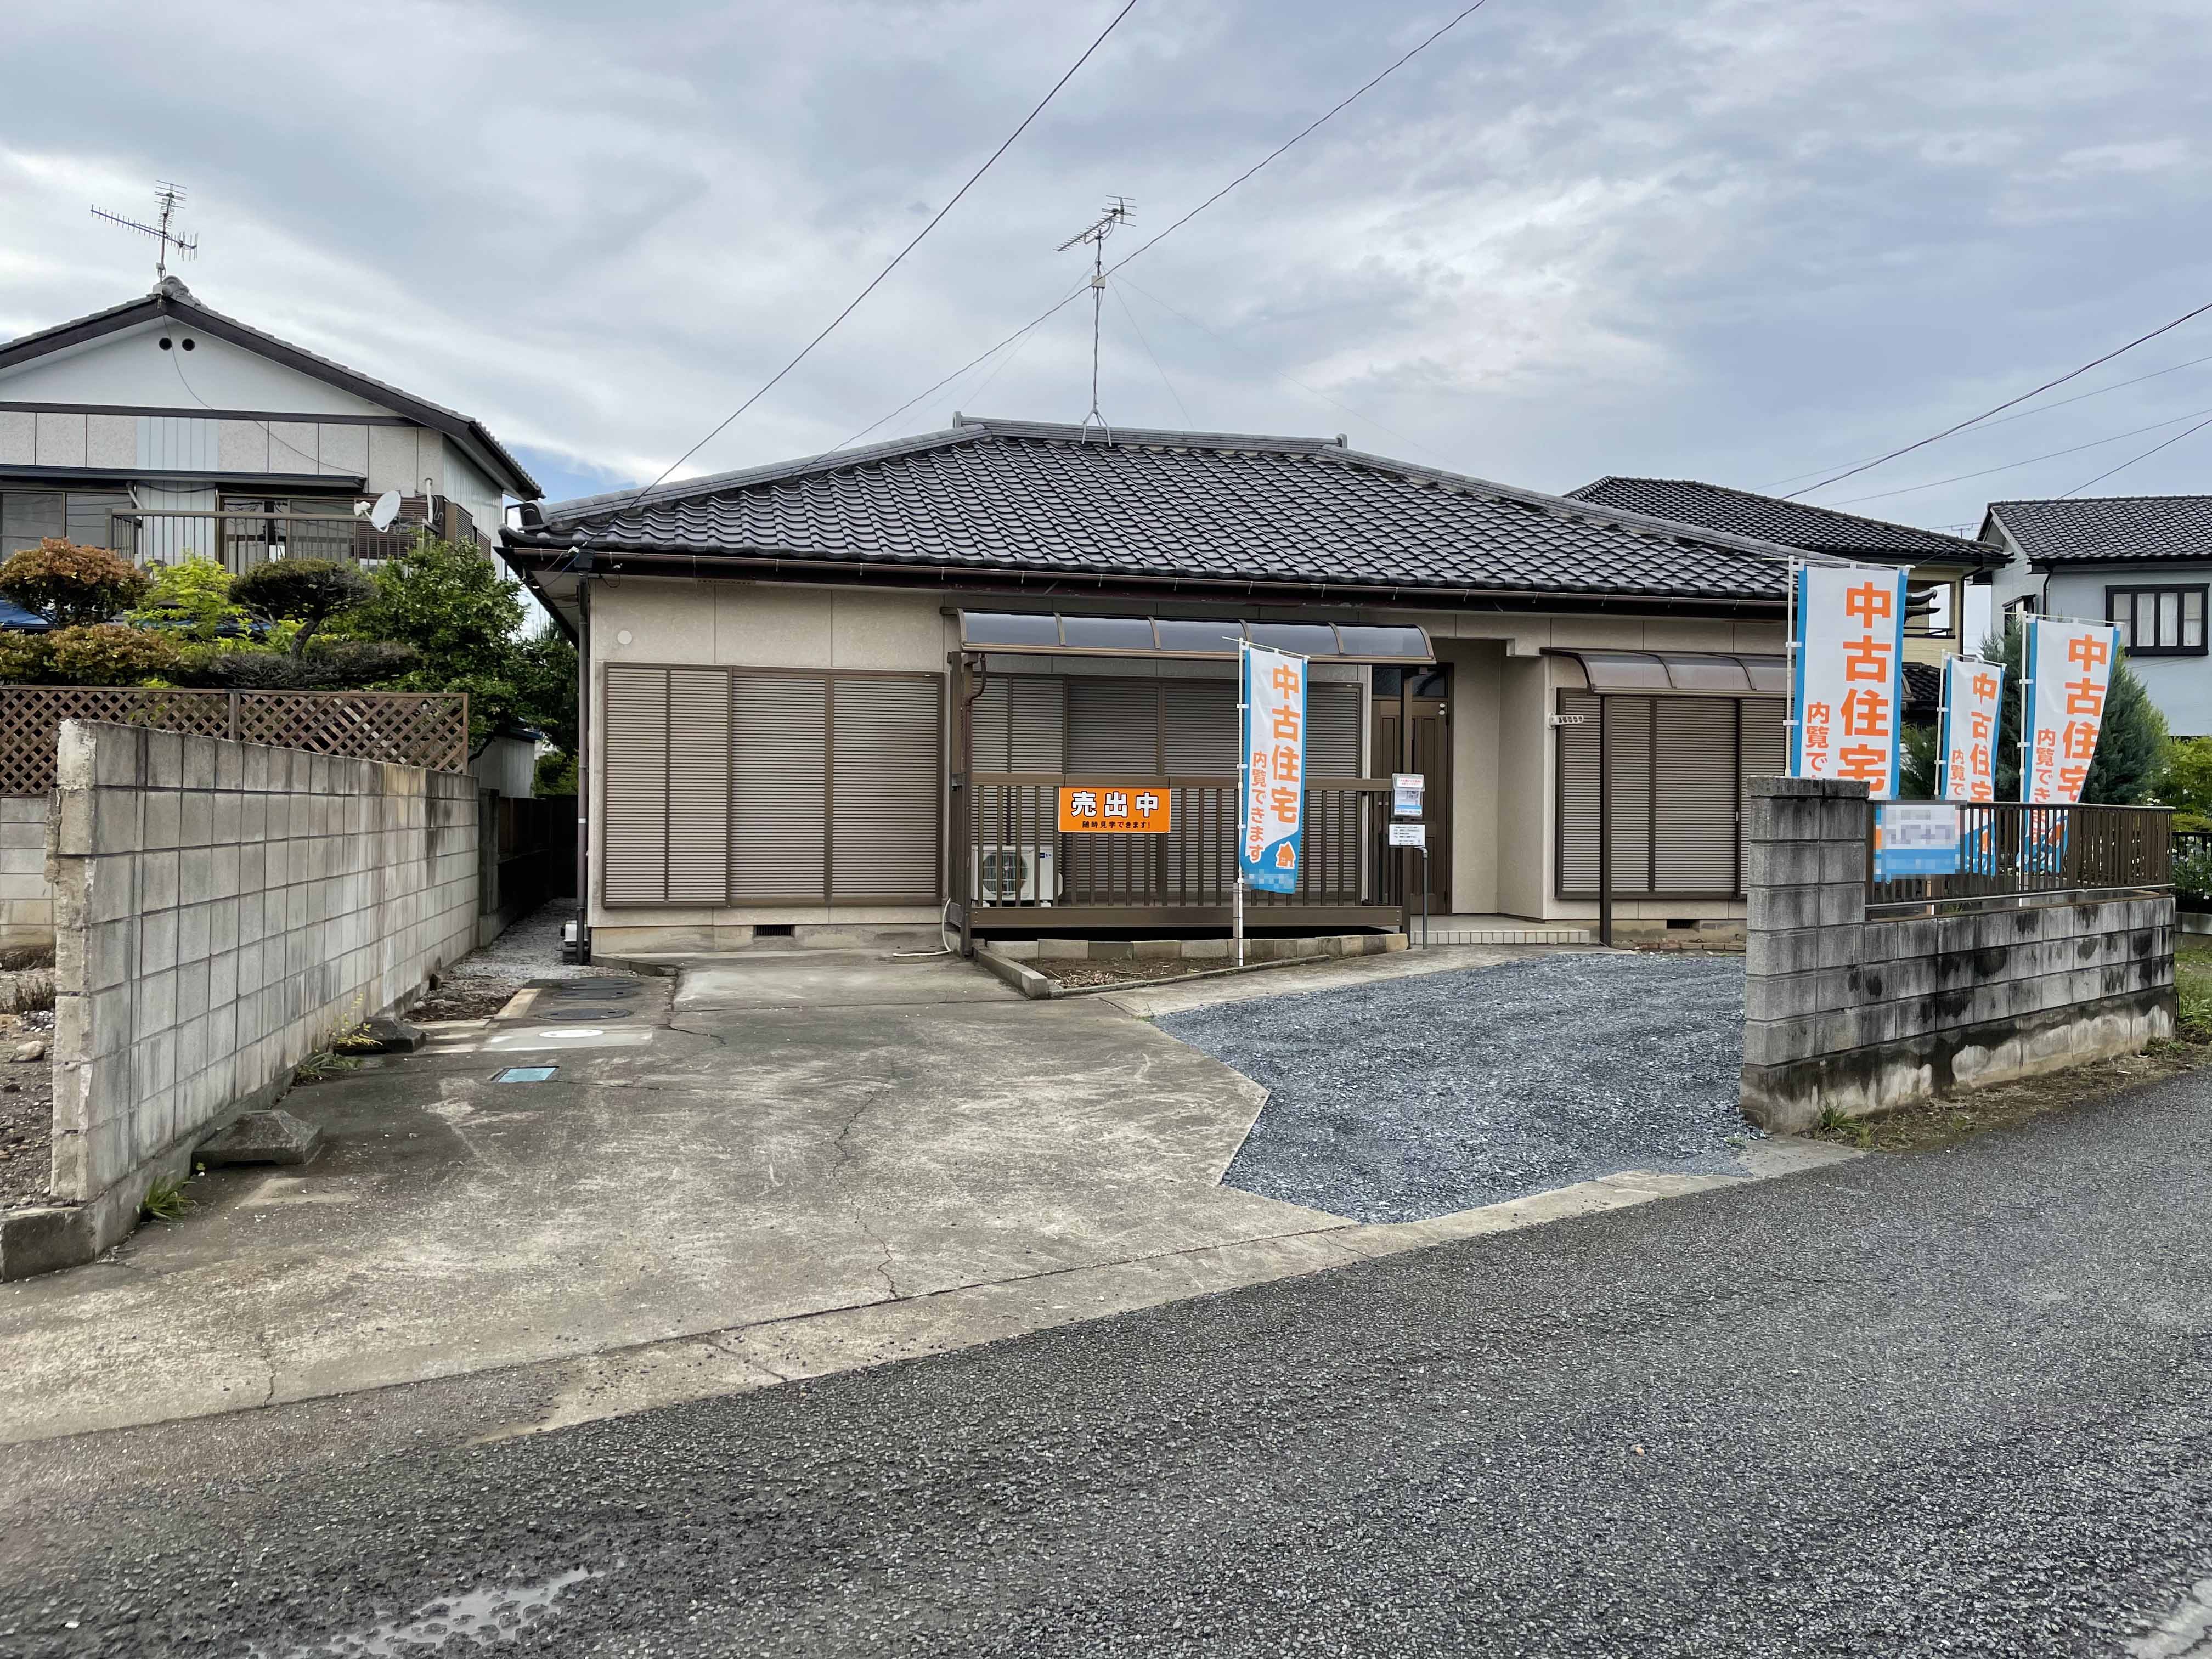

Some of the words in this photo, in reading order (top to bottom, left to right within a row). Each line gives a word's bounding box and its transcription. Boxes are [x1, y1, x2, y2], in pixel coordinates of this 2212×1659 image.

[1805, 702, 1830, 779] 内覧で
[1837, 582, 1891, 792] 中古住宅
[1270, 664, 1300, 823] 中古住宅
[1071, 791, 1159, 818] 売出中
[1249, 751, 1267, 861] 内覧できます
